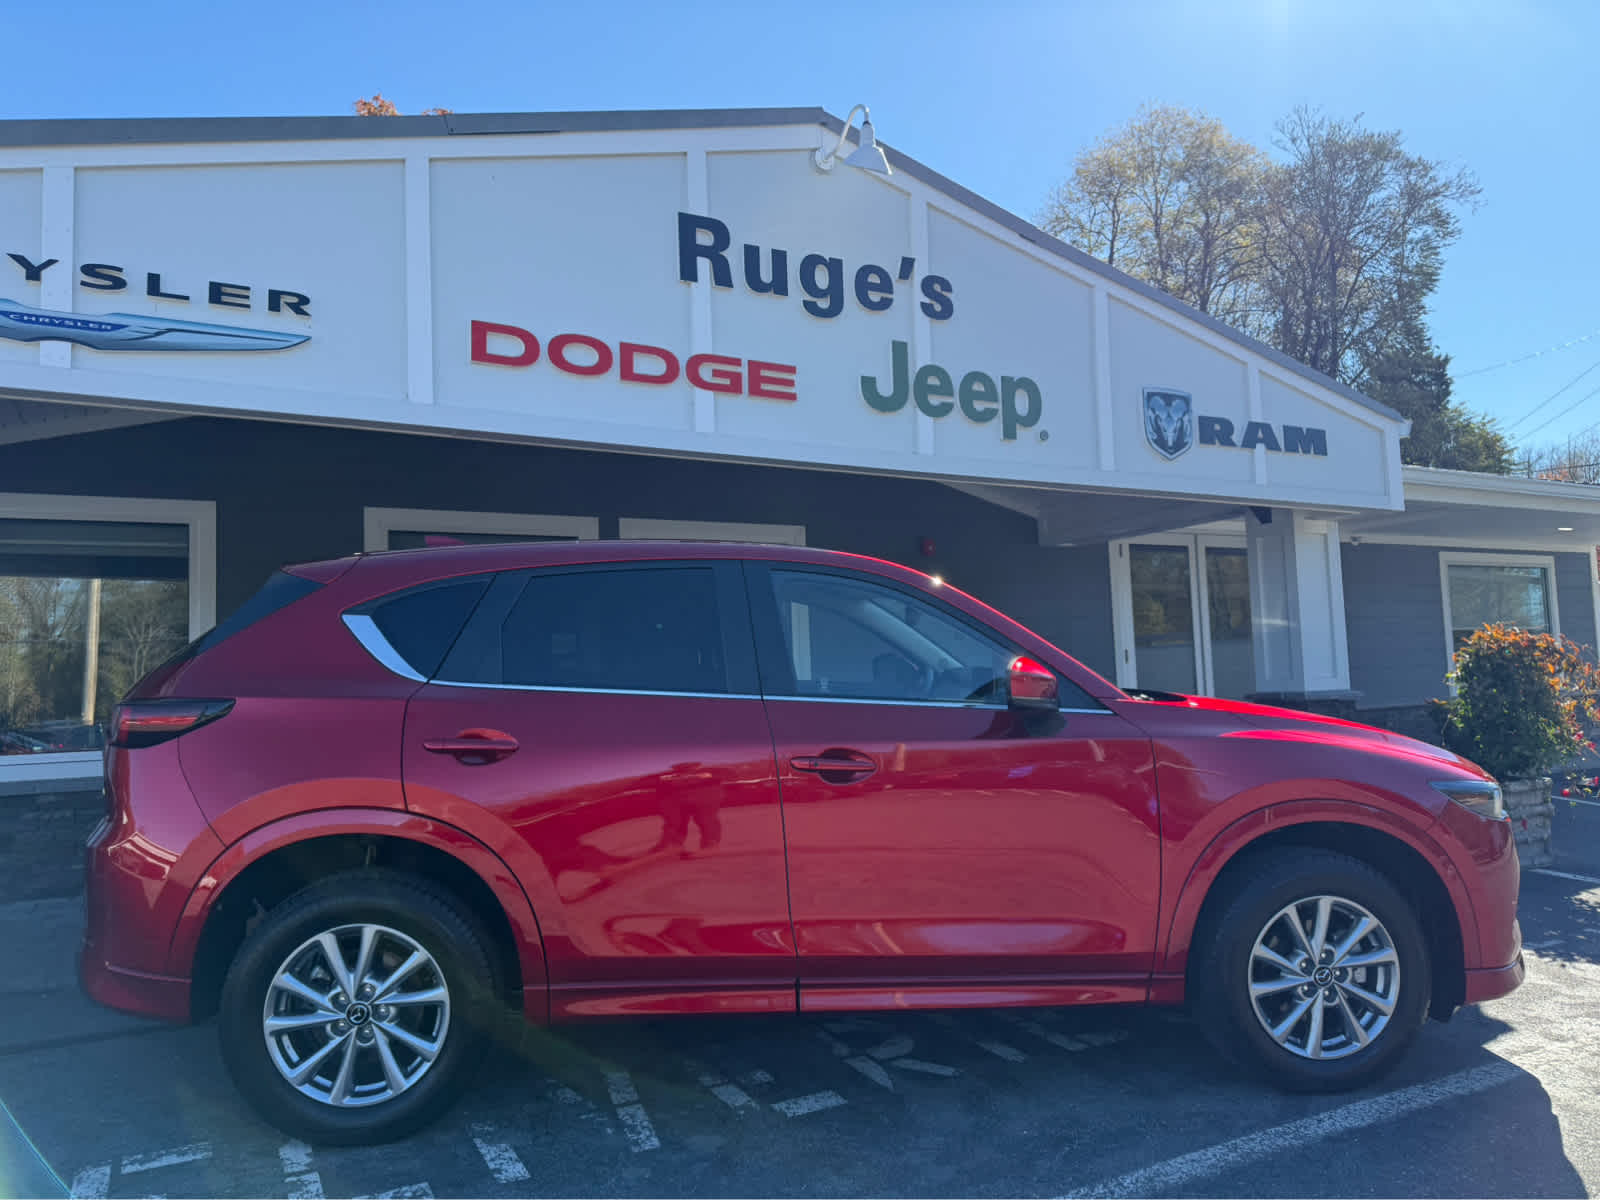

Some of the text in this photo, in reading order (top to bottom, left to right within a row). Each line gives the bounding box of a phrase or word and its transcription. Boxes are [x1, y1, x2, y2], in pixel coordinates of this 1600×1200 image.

[6, 252, 312, 317] YSLER
[677, 211, 955, 320] Ruge's
[470, 319, 798, 401] DODGE
[1198, 415, 1328, 457] RAM
